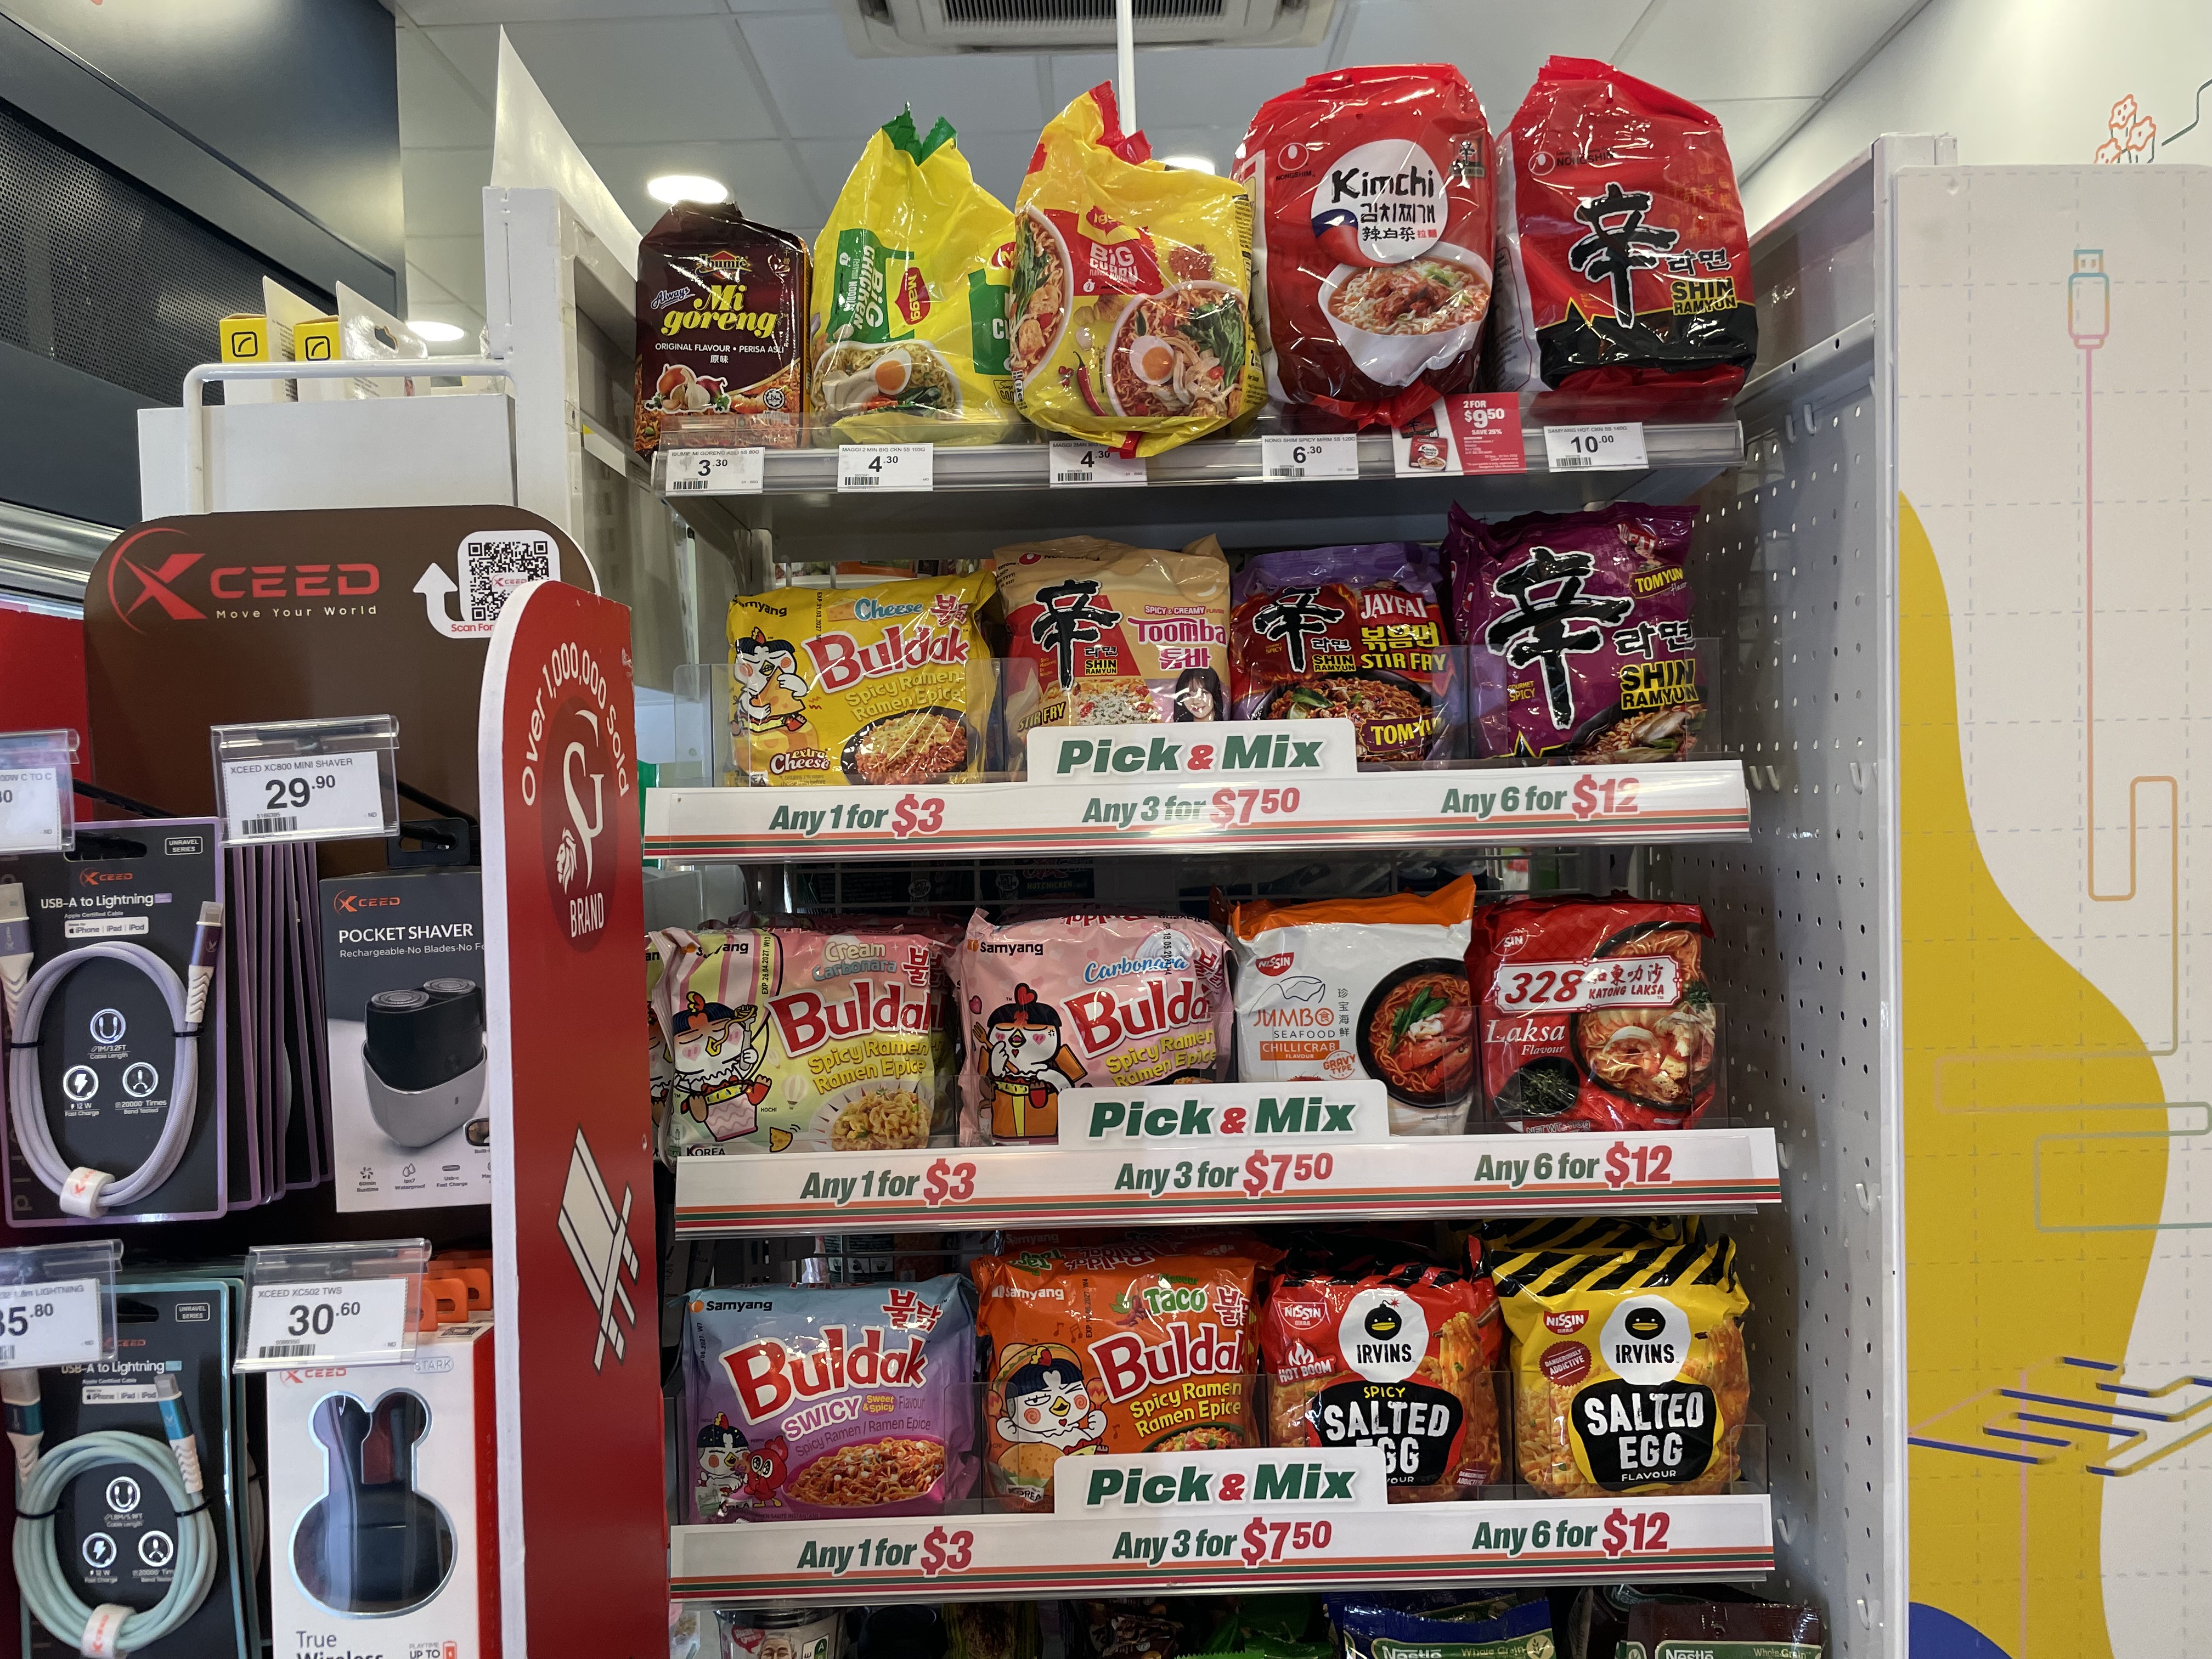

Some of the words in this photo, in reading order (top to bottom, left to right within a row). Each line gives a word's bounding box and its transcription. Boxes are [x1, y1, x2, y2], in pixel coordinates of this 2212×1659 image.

[1331, 166, 1435, 204] Kimchi
[1361, 203, 1436, 224] 김치찌개
[1568, 182, 1680, 329] 辛
[1666, 247, 1733, 275] 라면
[651, 286, 691, 309] Always
[693, 284, 747, 312] Mi
[1671, 276, 1735, 301] SHIN
[1673, 298, 1737, 315] RAMYUN
[661, 310, 778, 339] goreng
[655, 343, 692, 351] ORIGINAL
[695, 344, 730, 352] FLAVOUR
[710, 355, 729, 363] 原味
[217, 608, 261, 618] Move
[272, 607, 312, 617] Your
[324, 605, 376, 616] World
[854, 597, 923, 621] Cheese
[1144, 606, 1166, 614] SPICY
[1173, 606, 1206, 615] CREAMY
[1360, 591, 1428, 619] JAYFAI
[452, 623, 476, 631] Scan
[477, 623, 493, 631] For
[1127, 616, 1228, 646] Toomba
[802, 624, 970, 693] Buldak
[1360, 653, 1407, 670] STIR
[1410, 653, 1446, 672] FRY
[1621, 658, 1695, 692] SHIN
[845, 681, 896, 707] Spicy
[899, 670, 960, 690] Ramen
[1509, 689, 1535, 702] SPICY
[1622, 685, 1699, 710] RAMYUN
[854, 700, 914, 721] Ramen
[917, 687, 961, 707] Epice
[230, 765, 262, 774] XCEED
[263, 763, 292, 773] XC800
[294, 761, 314, 770] MINI
[315, 758, 353, 769] SHAVER
[1057, 736, 1180, 774] Pick
[1186, 743, 1214, 770] &
[1221, 735, 1323, 770] Mix
[41, 898, 78, 909] USB-A
[81, 897, 93, 907] to
[96, 894, 154, 908] Lightning
[569, 892, 605, 938] BRAND
[338, 927, 405, 944] POCKET
[408, 923, 473, 940] SHAVER
[1504, 935, 1524, 948] SIN
[825, 940, 887, 963] Cream
[980, 941, 1043, 956] Samyang
[812, 958, 897, 983] Carbonara
[1084, 956, 1189, 984] Carbonara
[1258, 956, 1291, 969] NISSIN
[1505, 969, 1585, 1005] 328
[1589, 985, 1626, 1000] KATONG
[1630, 984, 1664, 996] LAKSA
[1274, 1030, 1335, 1039] SEAFOOD
[1485, 1018, 1565, 1043] Laksa
[808, 1045, 862, 1074] Spicy
[865, 1039, 930, 1062] Ramen
[1262, 1043, 1301, 1052] CHILLI
[1304, 1043, 1336, 1052] CRAB
[1521, 1043, 1565, 1056] Flavour
[1323, 1054, 1356, 1071] GRAVY
[1330, 1064, 1353, 1075] TYPE
[814, 1063, 877, 1095] Ramen
[881, 1056, 927, 1081] Epice
[1088, 1099, 1215, 1138] Pick
[1220, 1107, 1246, 1134] &
[1254, 1097, 1356, 1133] Mix
[1475, 1154, 1530, 1187] Any
[1534, 1153, 1553, 1181] 6
[1558, 1152, 1600, 1180] for
[1604, 1141, 1672, 1189] $12
[800, 1172, 857, 1205] Any
[924, 1158, 977, 1206] $3
[1114, 1163, 1171, 1197] Any
[1175, 1161, 1192, 1188] 3
[1198, 1161, 1239, 1188] for
[258, 1289, 289, 1298] XCEED
[291, 1288, 320, 1297] XC502
[322, 1286, 342, 1295] TWS
[1006, 1288, 1064, 1301] Samyang
[1144, 1286, 1207, 1316] Taco
[706, 1300, 773, 1312] Samyang
[1284, 1304, 1321, 1321] NISSIN
[1546, 1314, 1585, 1329] NISSIN
[415, 1359, 451, 1372] STARK
[1356, 1344, 1412, 1364] IRVINS
[1545, 1349, 1582, 1367] DANGEROUSLY
[1616, 1344, 1675, 1364] IRVINS
[720, 1324, 929, 1426] Buldak
[1278, 1367, 1300, 1383] HOT
[1302, 1359, 1333, 1378] BOOM
[1549, 1356, 1585, 1376] ADDICTIVE
[866, 1395, 894, 1404] Sweet
[899, 1395, 926, 1410] Flavour
[1130, 1390, 1181, 1419] Spicy
[1182, 1381, 1242, 1400] Ramen
[1364, 1386, 1406, 1398] SPICY
[782, 1395, 862, 1442] SWICY
[1135, 1407, 1195, 1438] Ramen
[1199, 1398, 1242, 1420] Epice
[1324, 1400, 1451, 1441] SALTED
[1584, 1391, 1704, 1436] SALTED
[1619, 1432, 1683, 1470] EGG
[1087, 1465, 1217, 1506] Pick
[1219, 1472, 1245, 1501] &
[1253, 1463, 1356, 1500] Mix
[1622, 1470, 1677, 1482] FLAVOUR
[296, 1630, 337, 1647] True
[409, 1650, 423, 1659] UP
[426, 1649, 440, 1658] TO
